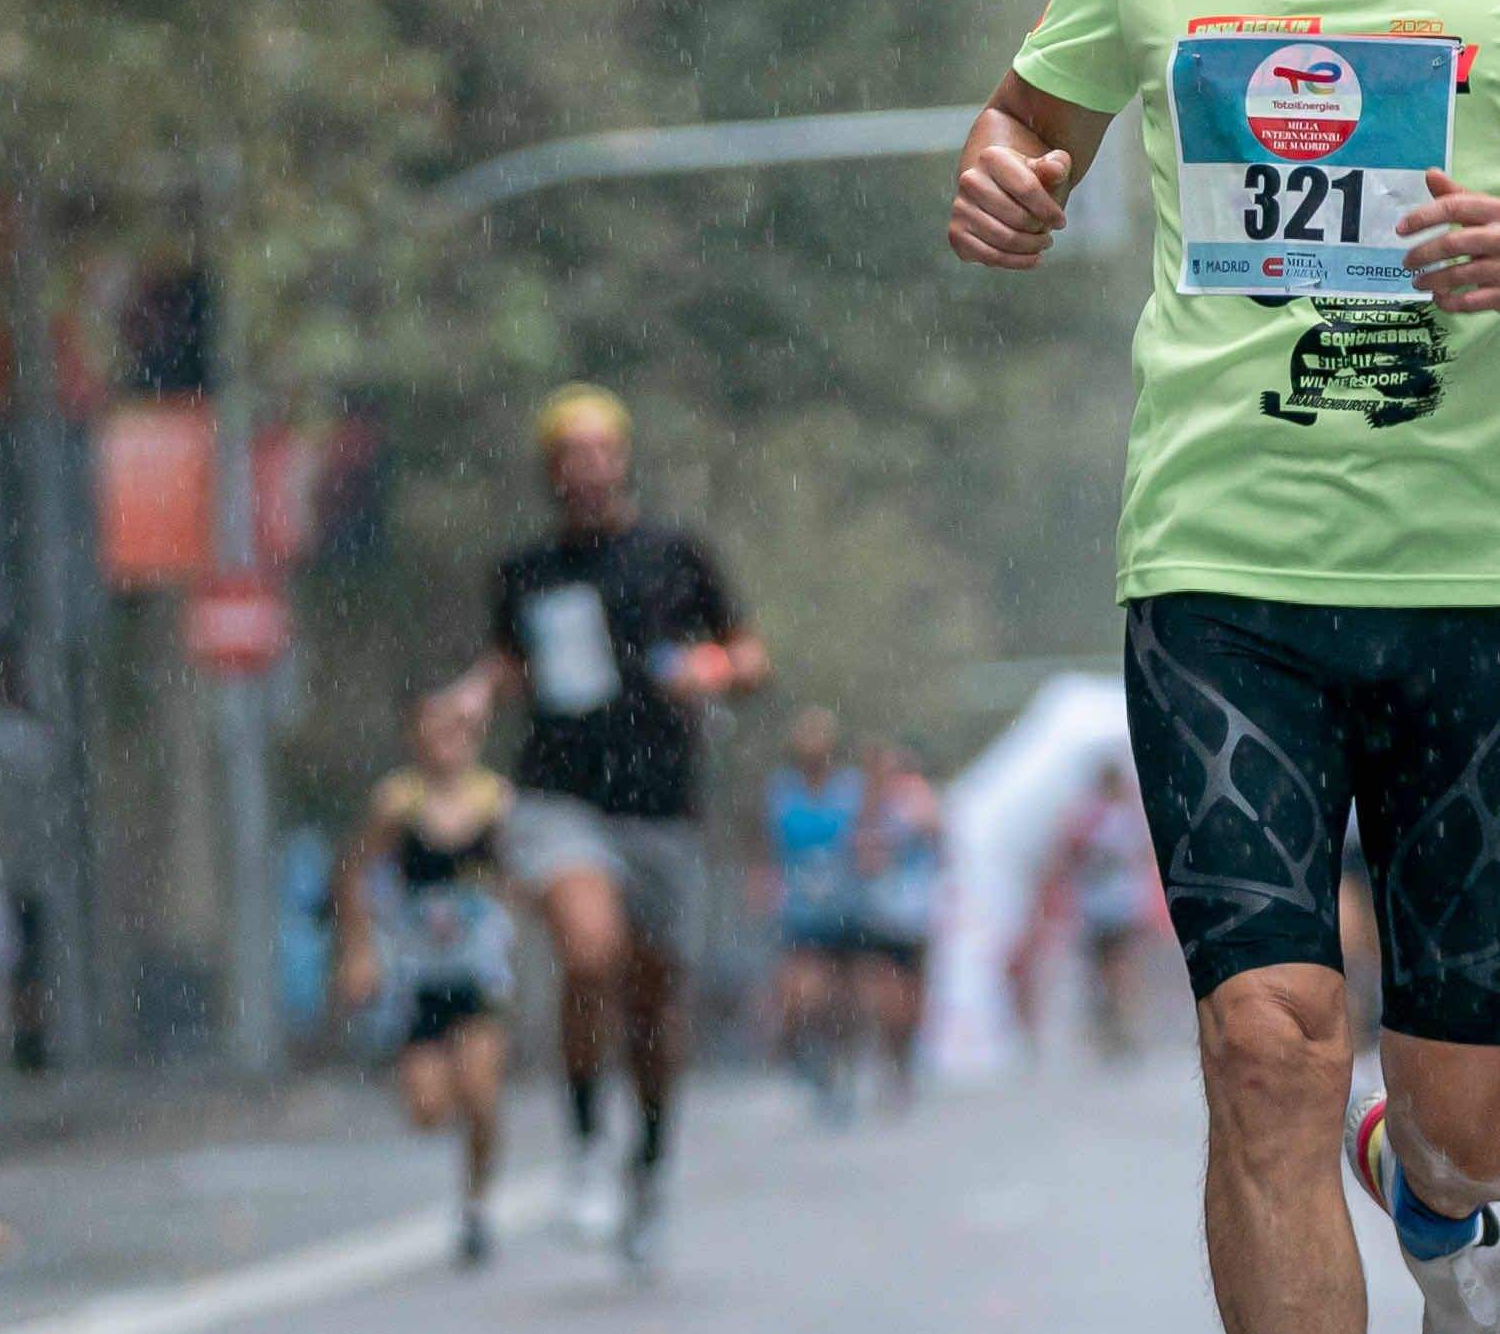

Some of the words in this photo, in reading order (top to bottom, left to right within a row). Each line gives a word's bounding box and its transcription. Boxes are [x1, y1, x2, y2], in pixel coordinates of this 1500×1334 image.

[1388, 18, 1445, 35] 2020
[1272, 99, 1341, 113] TotalEnergies
[1286, 120, 1320, 132] MILLA
[1261, 130, 1344, 143] INTERNACIONAL
[1272, 140, 1288, 151] DE
[1289, 141, 1331, 152] MADRID
[1243, 164, 1365, 244] 321
[1205, 260, 1252, 274] MADRID
[1286, 257, 1324, 269] MILLA
[1299, 372, 1410, 389] WILMERSDORF
